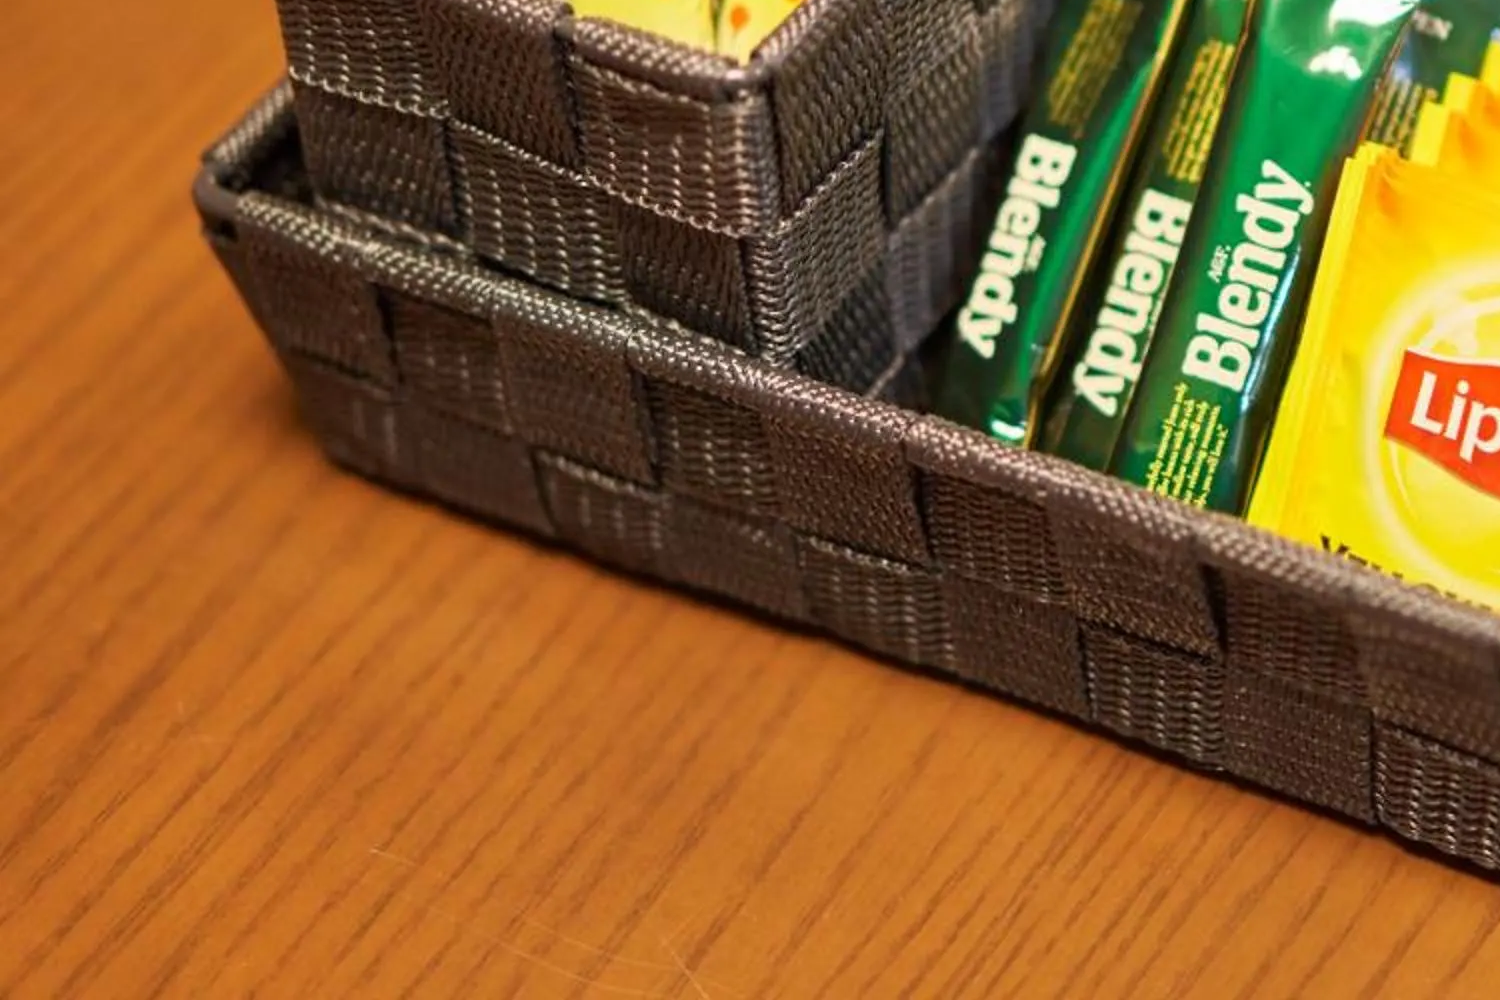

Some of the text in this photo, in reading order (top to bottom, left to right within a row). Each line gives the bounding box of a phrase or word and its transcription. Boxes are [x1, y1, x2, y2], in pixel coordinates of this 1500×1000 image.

[958, 133, 1077, 358] Blendy
[1073, 190, 1192, 417] Blendy
[1182, 160, 1313, 392] Blendy
